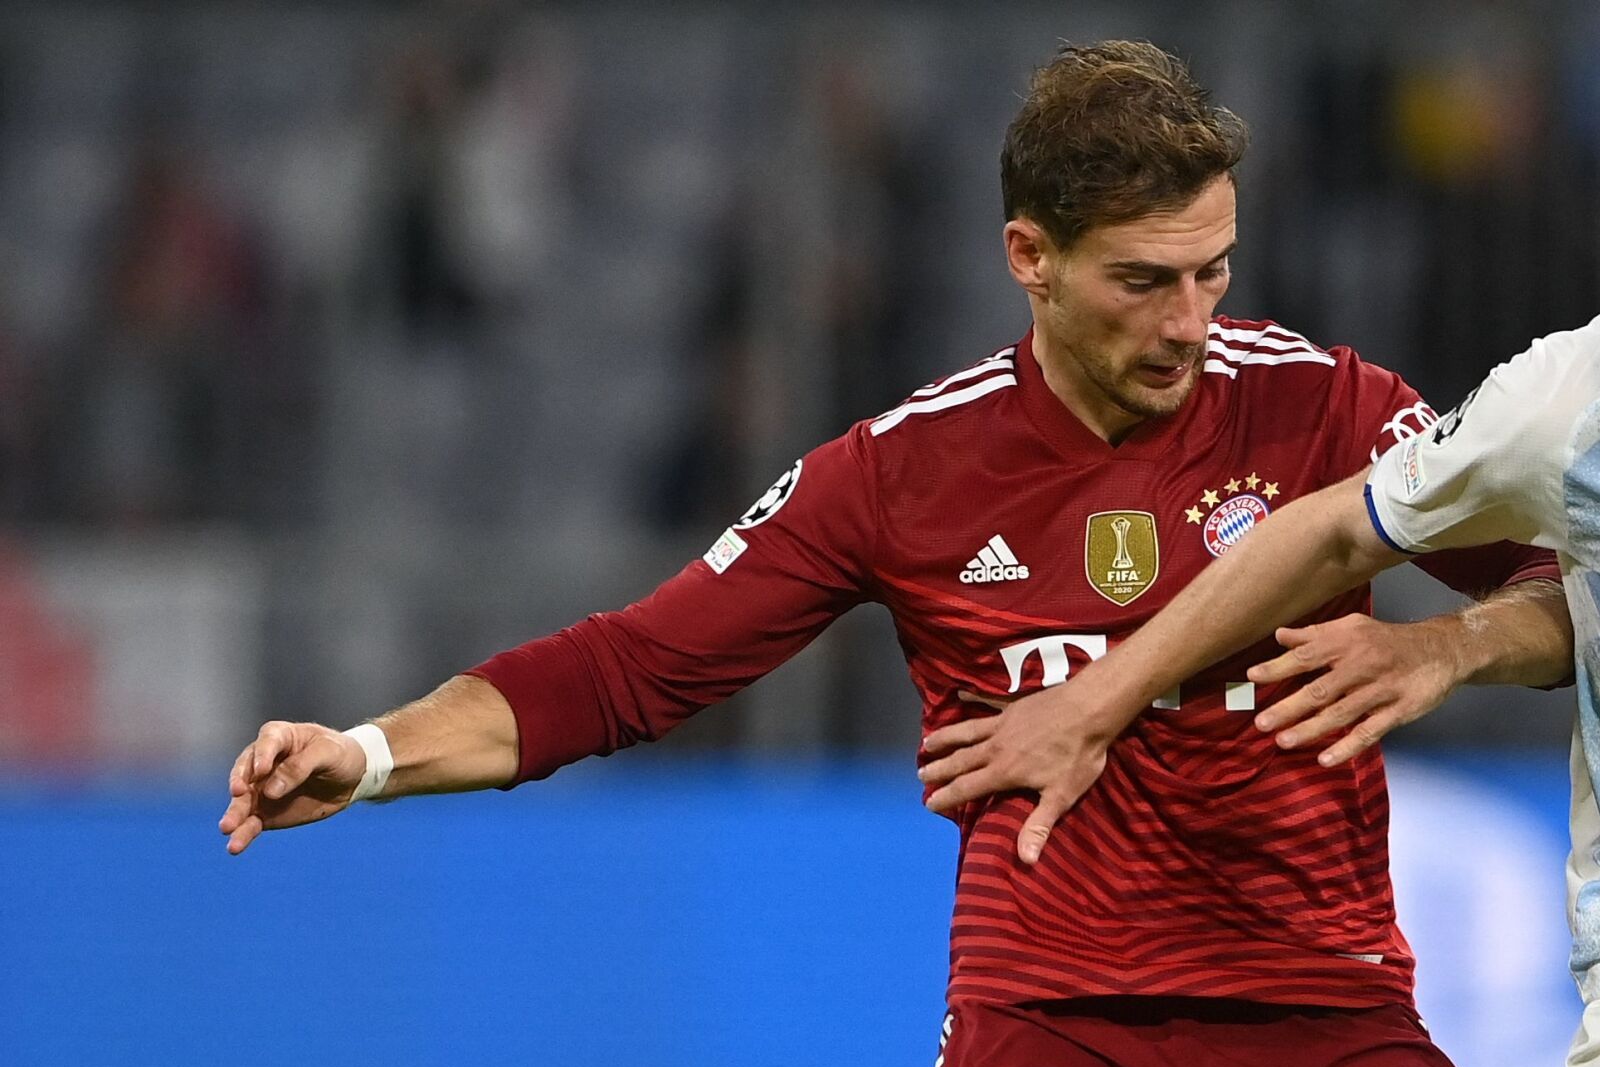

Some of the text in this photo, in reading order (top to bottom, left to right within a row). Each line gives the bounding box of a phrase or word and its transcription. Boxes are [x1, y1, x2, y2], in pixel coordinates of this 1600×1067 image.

[1220, 498, 1262, 516] BAYERN
[959, 565, 1030, 584] adidas
[1107, 570, 1139, 582] FIFA
[1113, 586, 1133, 594] 2020
